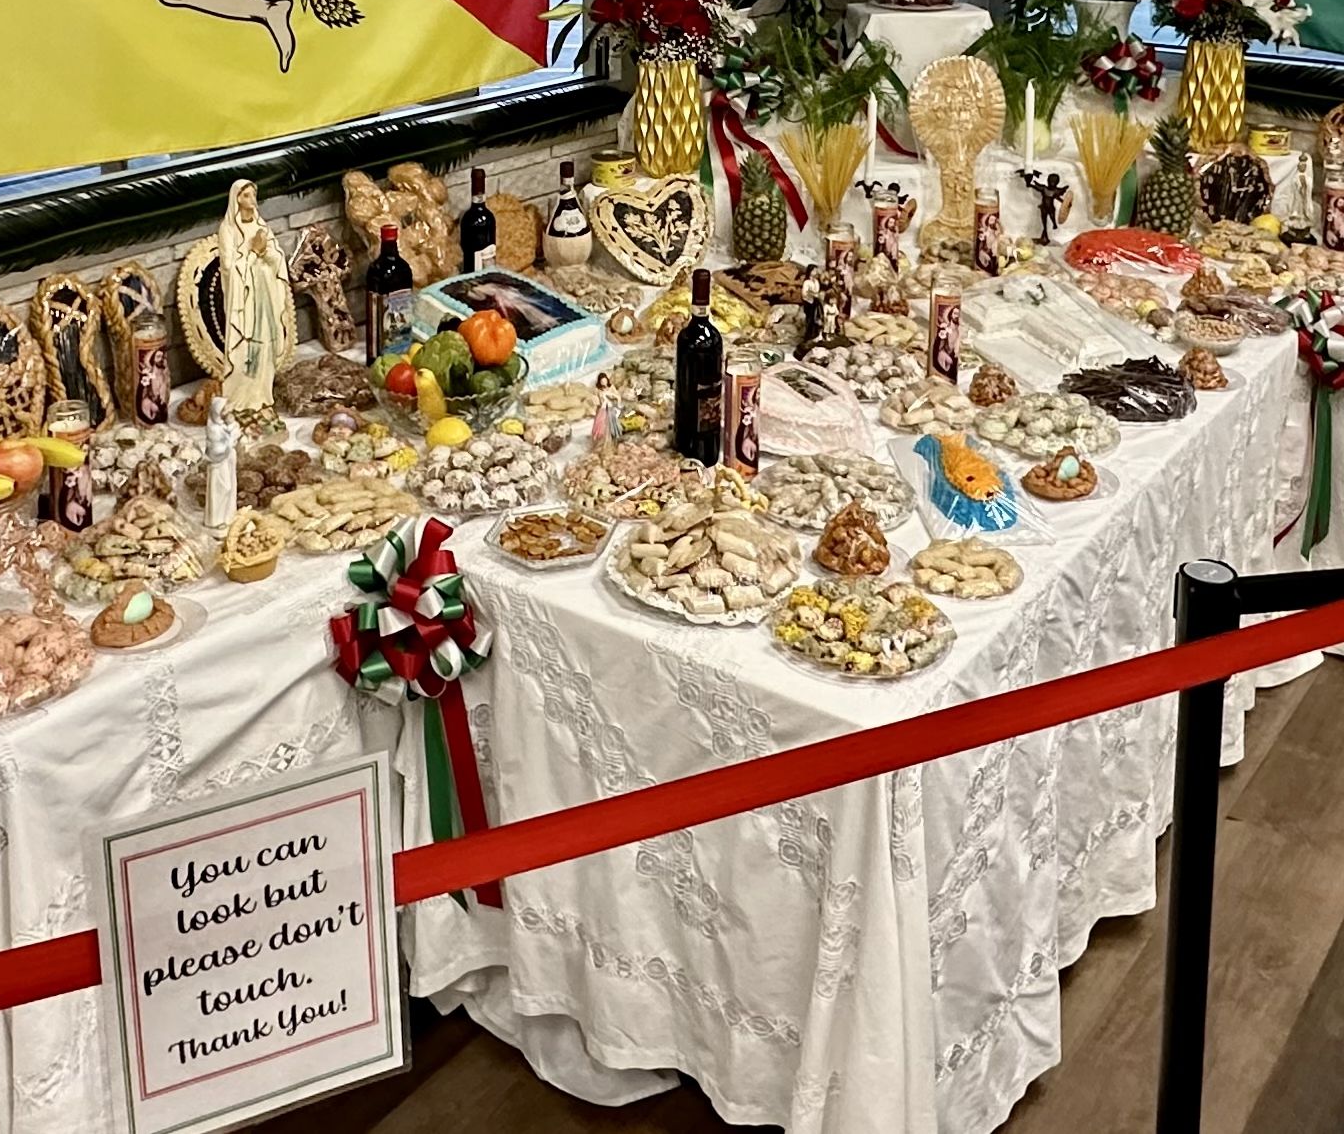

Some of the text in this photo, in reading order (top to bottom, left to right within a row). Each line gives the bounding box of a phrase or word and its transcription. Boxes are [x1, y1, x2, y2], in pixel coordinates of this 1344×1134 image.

[171, 831, 328, 898] You can
[175, 868, 328, 935] look but
[142, 900, 365, 997] please don't
[195, 967, 314, 1016] touch.
[167, 989, 348, 1065] Thank You!
